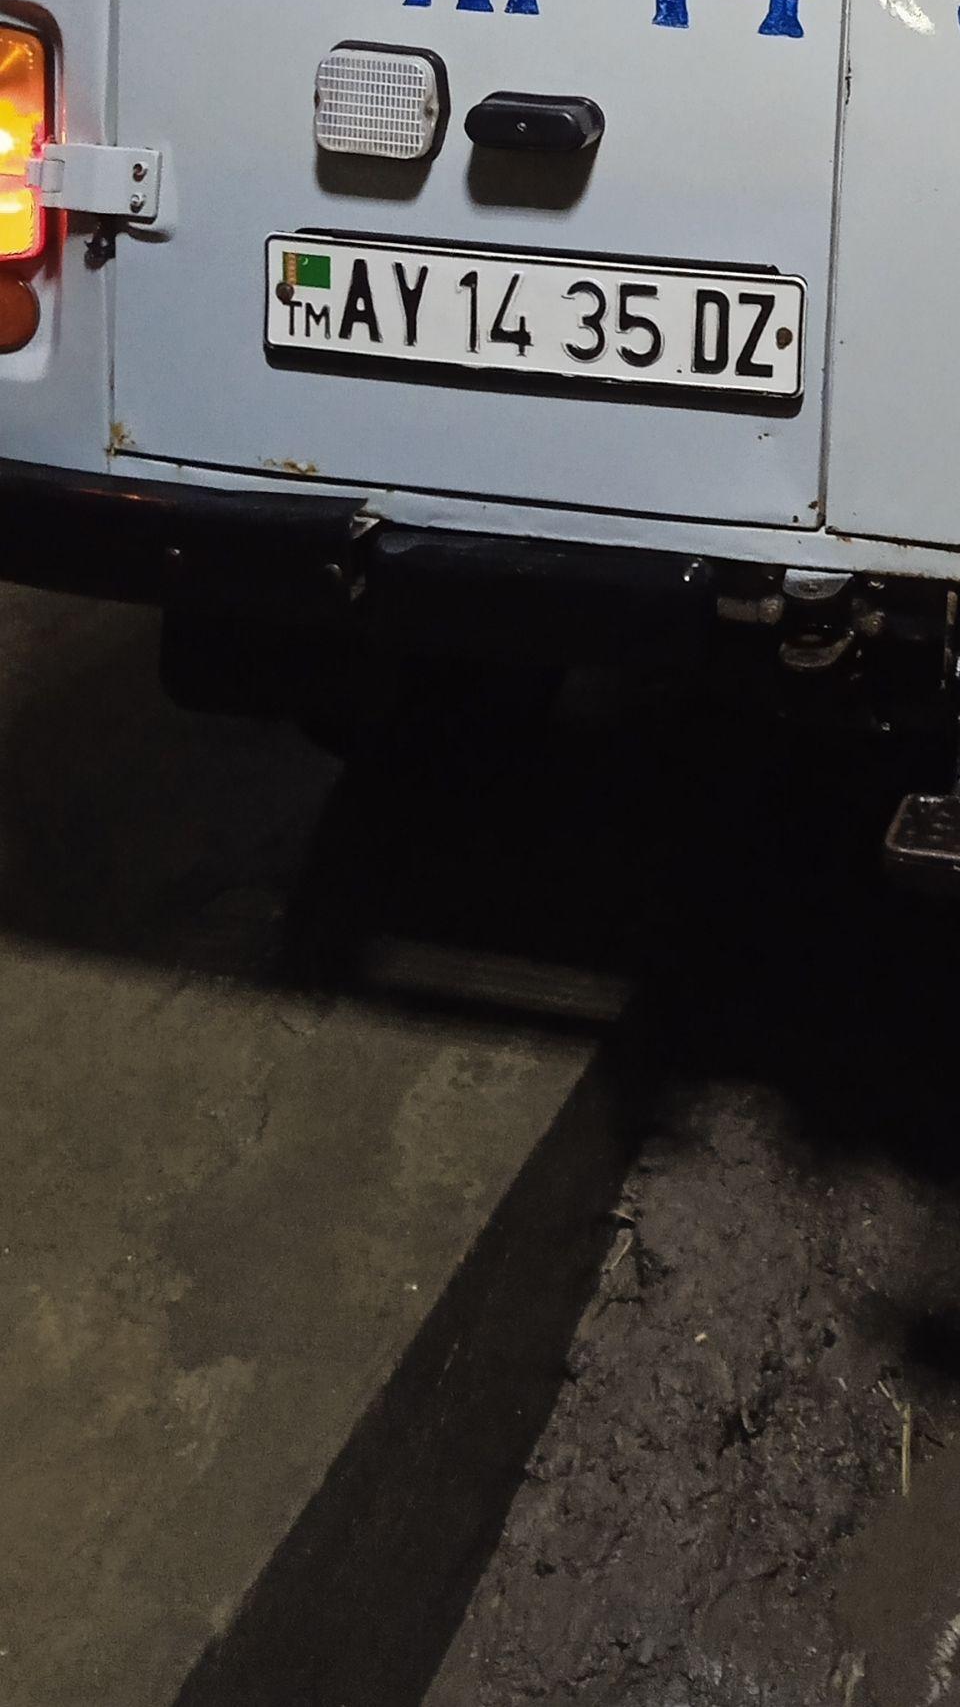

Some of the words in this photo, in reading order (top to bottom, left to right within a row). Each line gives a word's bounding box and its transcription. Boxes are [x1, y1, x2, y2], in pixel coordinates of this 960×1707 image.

[281, 299, 331, 340] TM
[338, 258, 429, 347] AY
[459, 269, 533, 357] 14
[561, 280, 665, 368] 35
[691, 289, 776, 378] DZ
